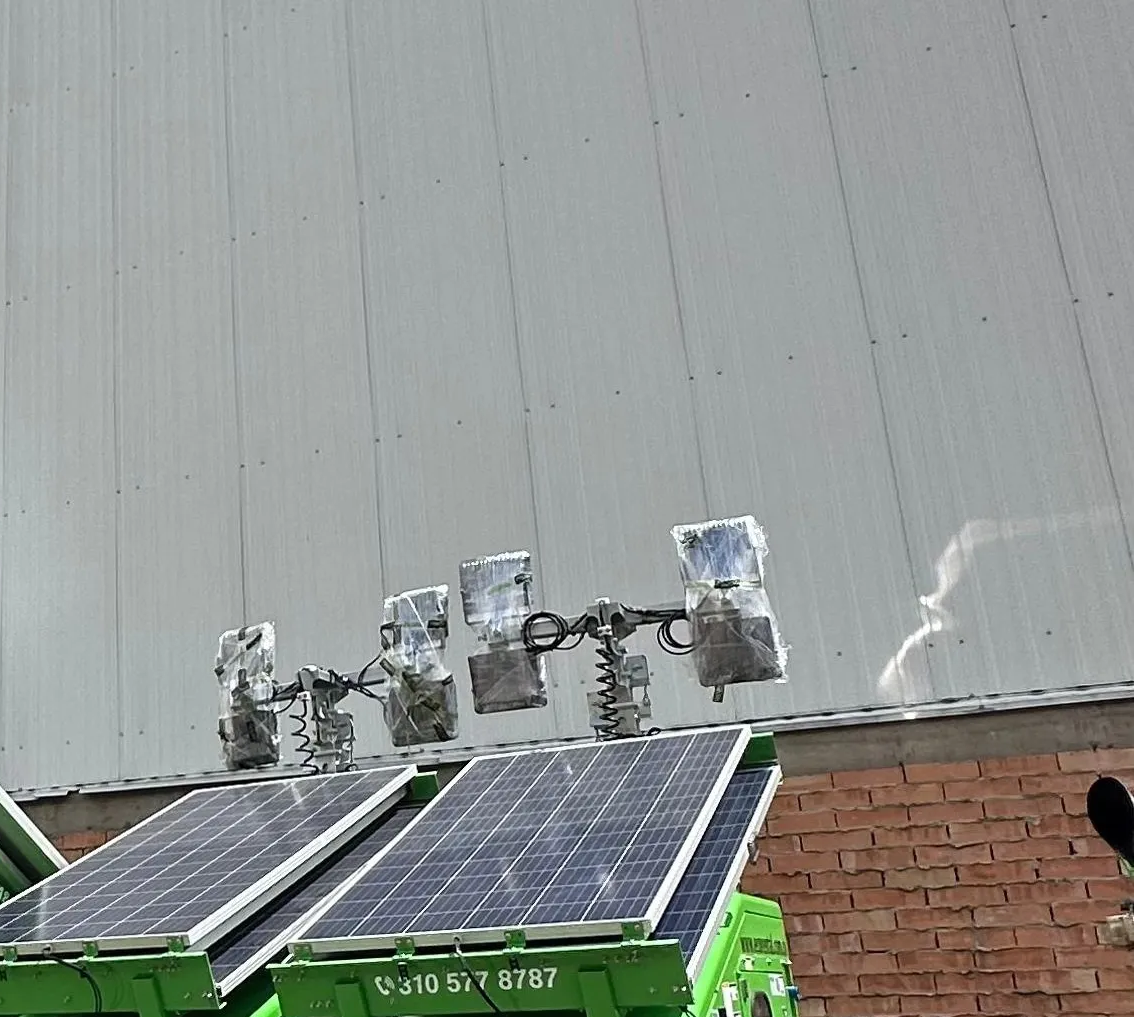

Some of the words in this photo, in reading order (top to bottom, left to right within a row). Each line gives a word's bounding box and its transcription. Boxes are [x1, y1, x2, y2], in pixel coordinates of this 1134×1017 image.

[398, 973, 440, 995] 310
[446, 970, 489, 993] 577
[498, 967, 558, 991] 8787
